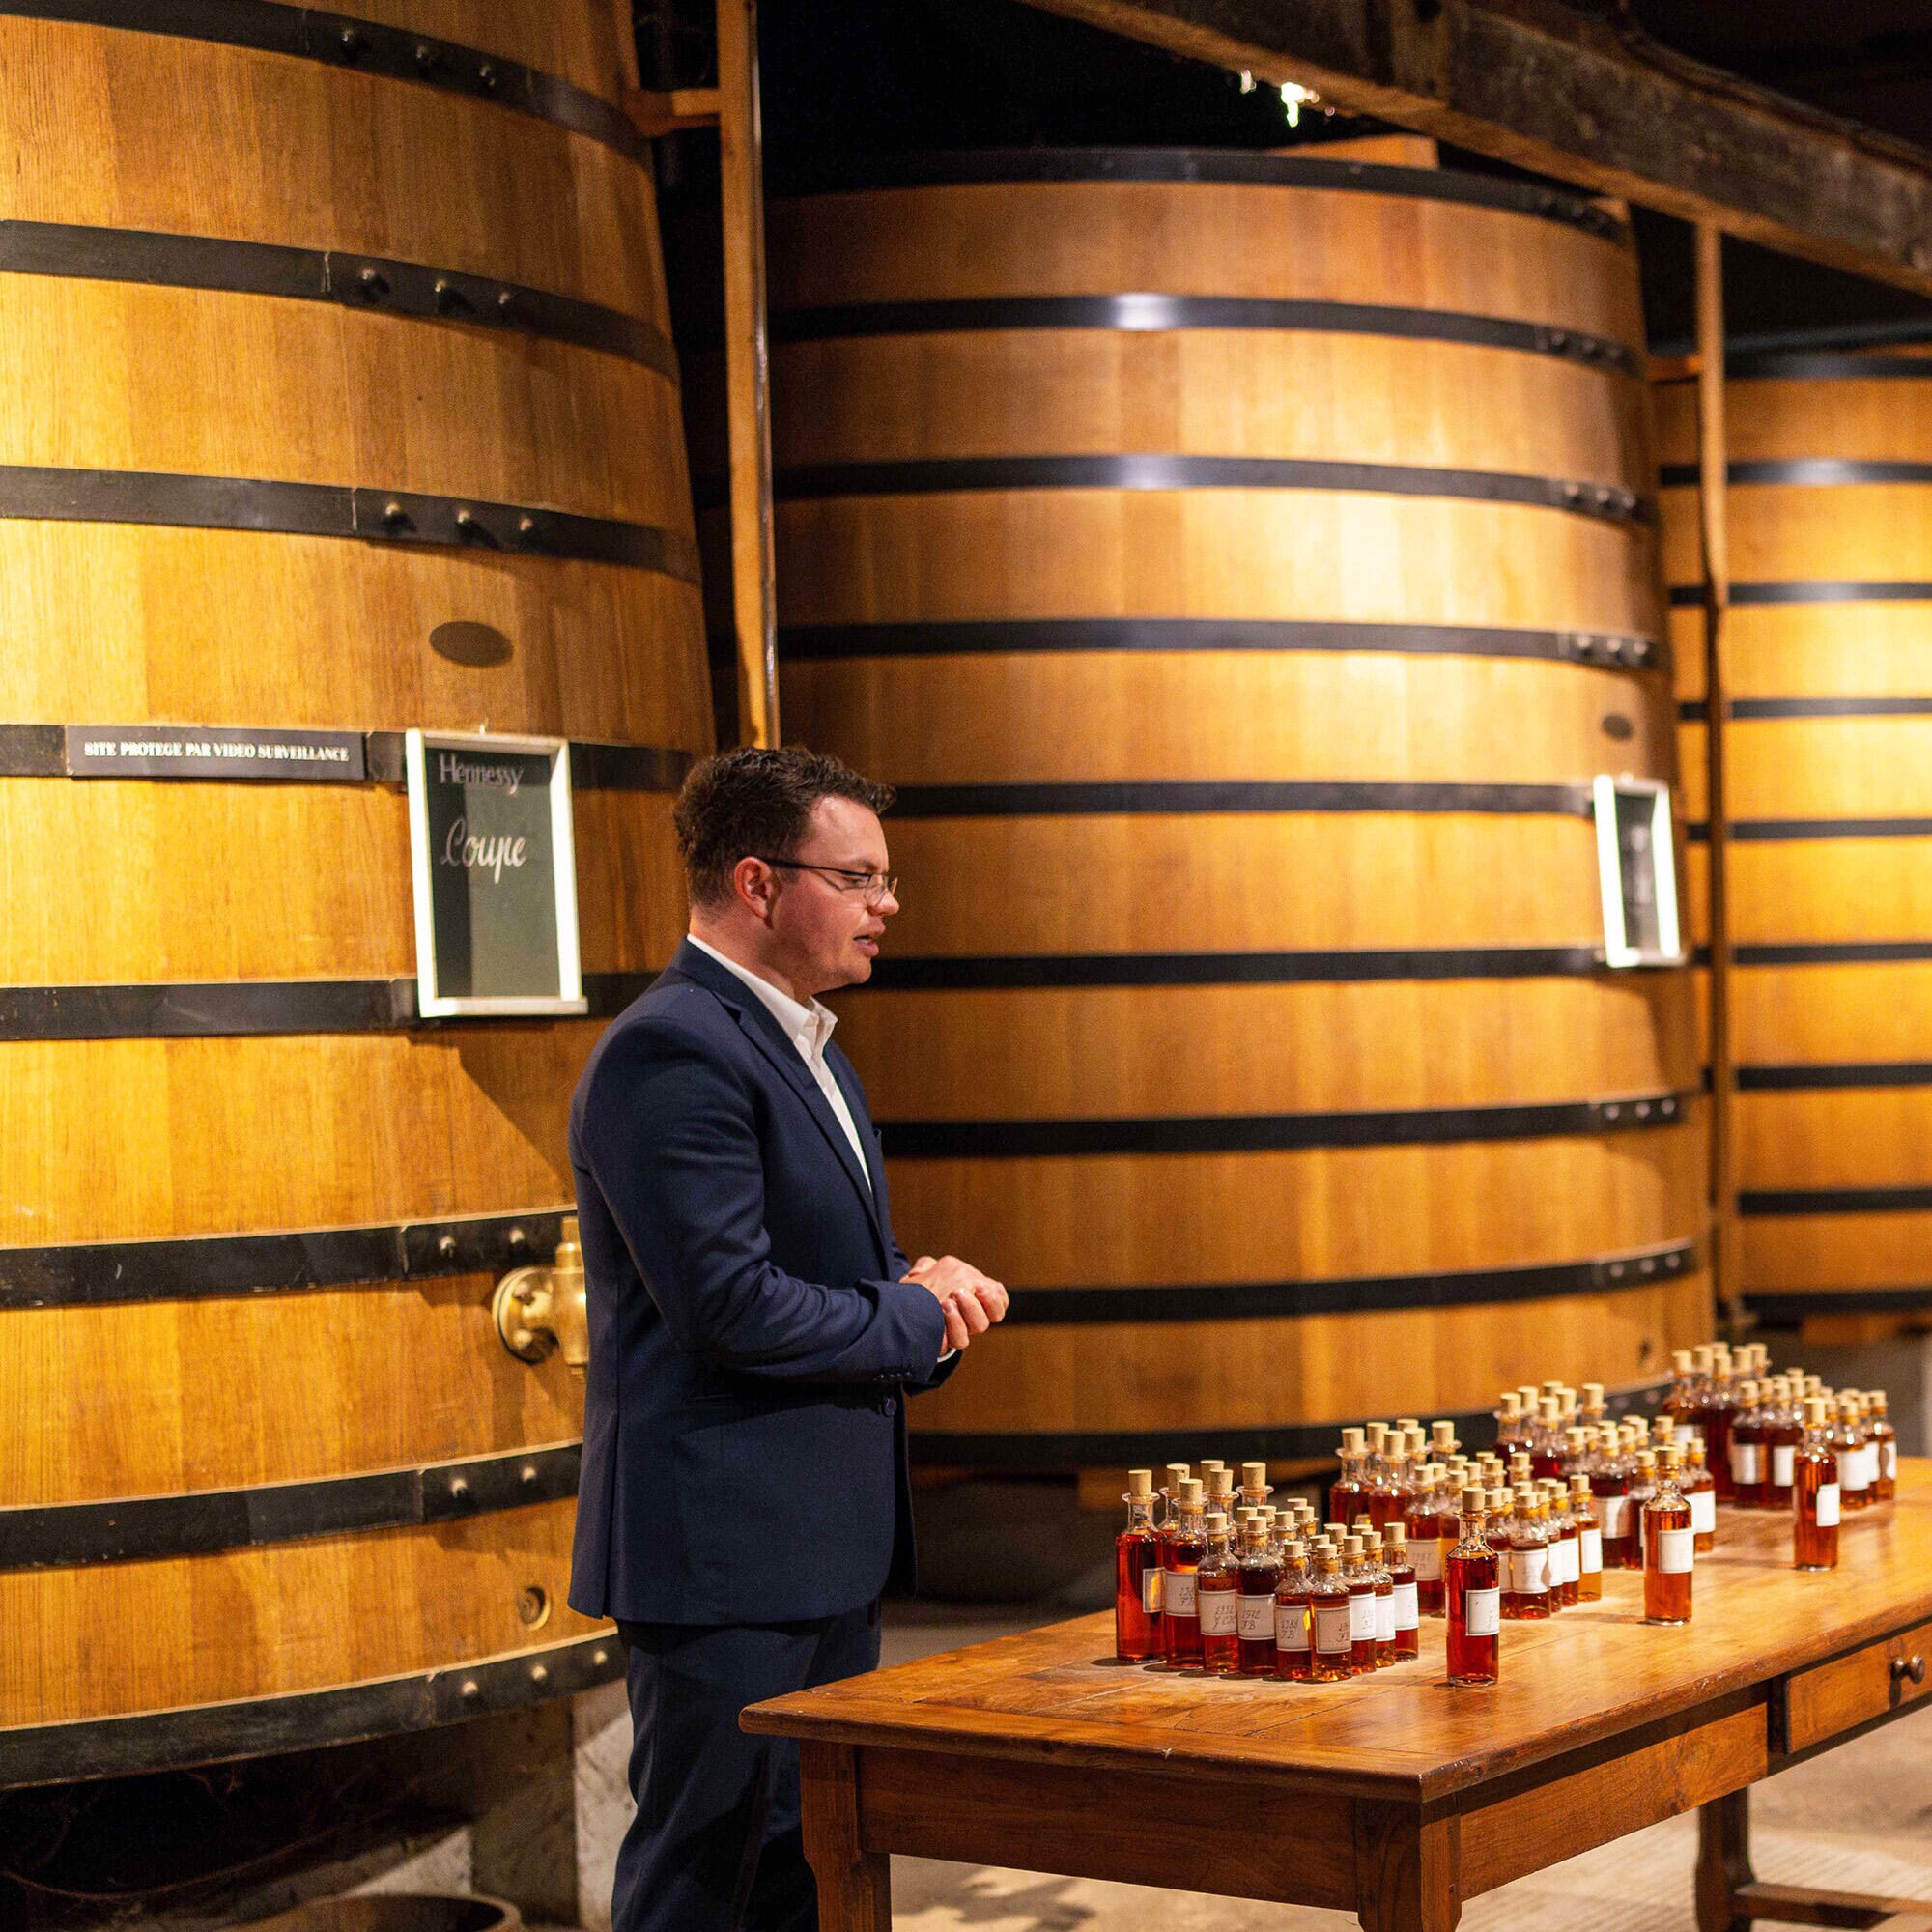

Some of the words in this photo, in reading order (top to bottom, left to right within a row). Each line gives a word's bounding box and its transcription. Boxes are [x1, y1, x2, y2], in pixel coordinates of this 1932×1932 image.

[84, 741, 117, 756] SITE
[120, 741, 183, 757] PROTEGE
[185, 742, 211, 757] PAR
[213, 742, 256, 758] VIDEO
[258, 743, 350, 762] SURVEILLANCE
[439, 753, 524, 795] Hennessy
[440, 818, 527, 884] Coupe
